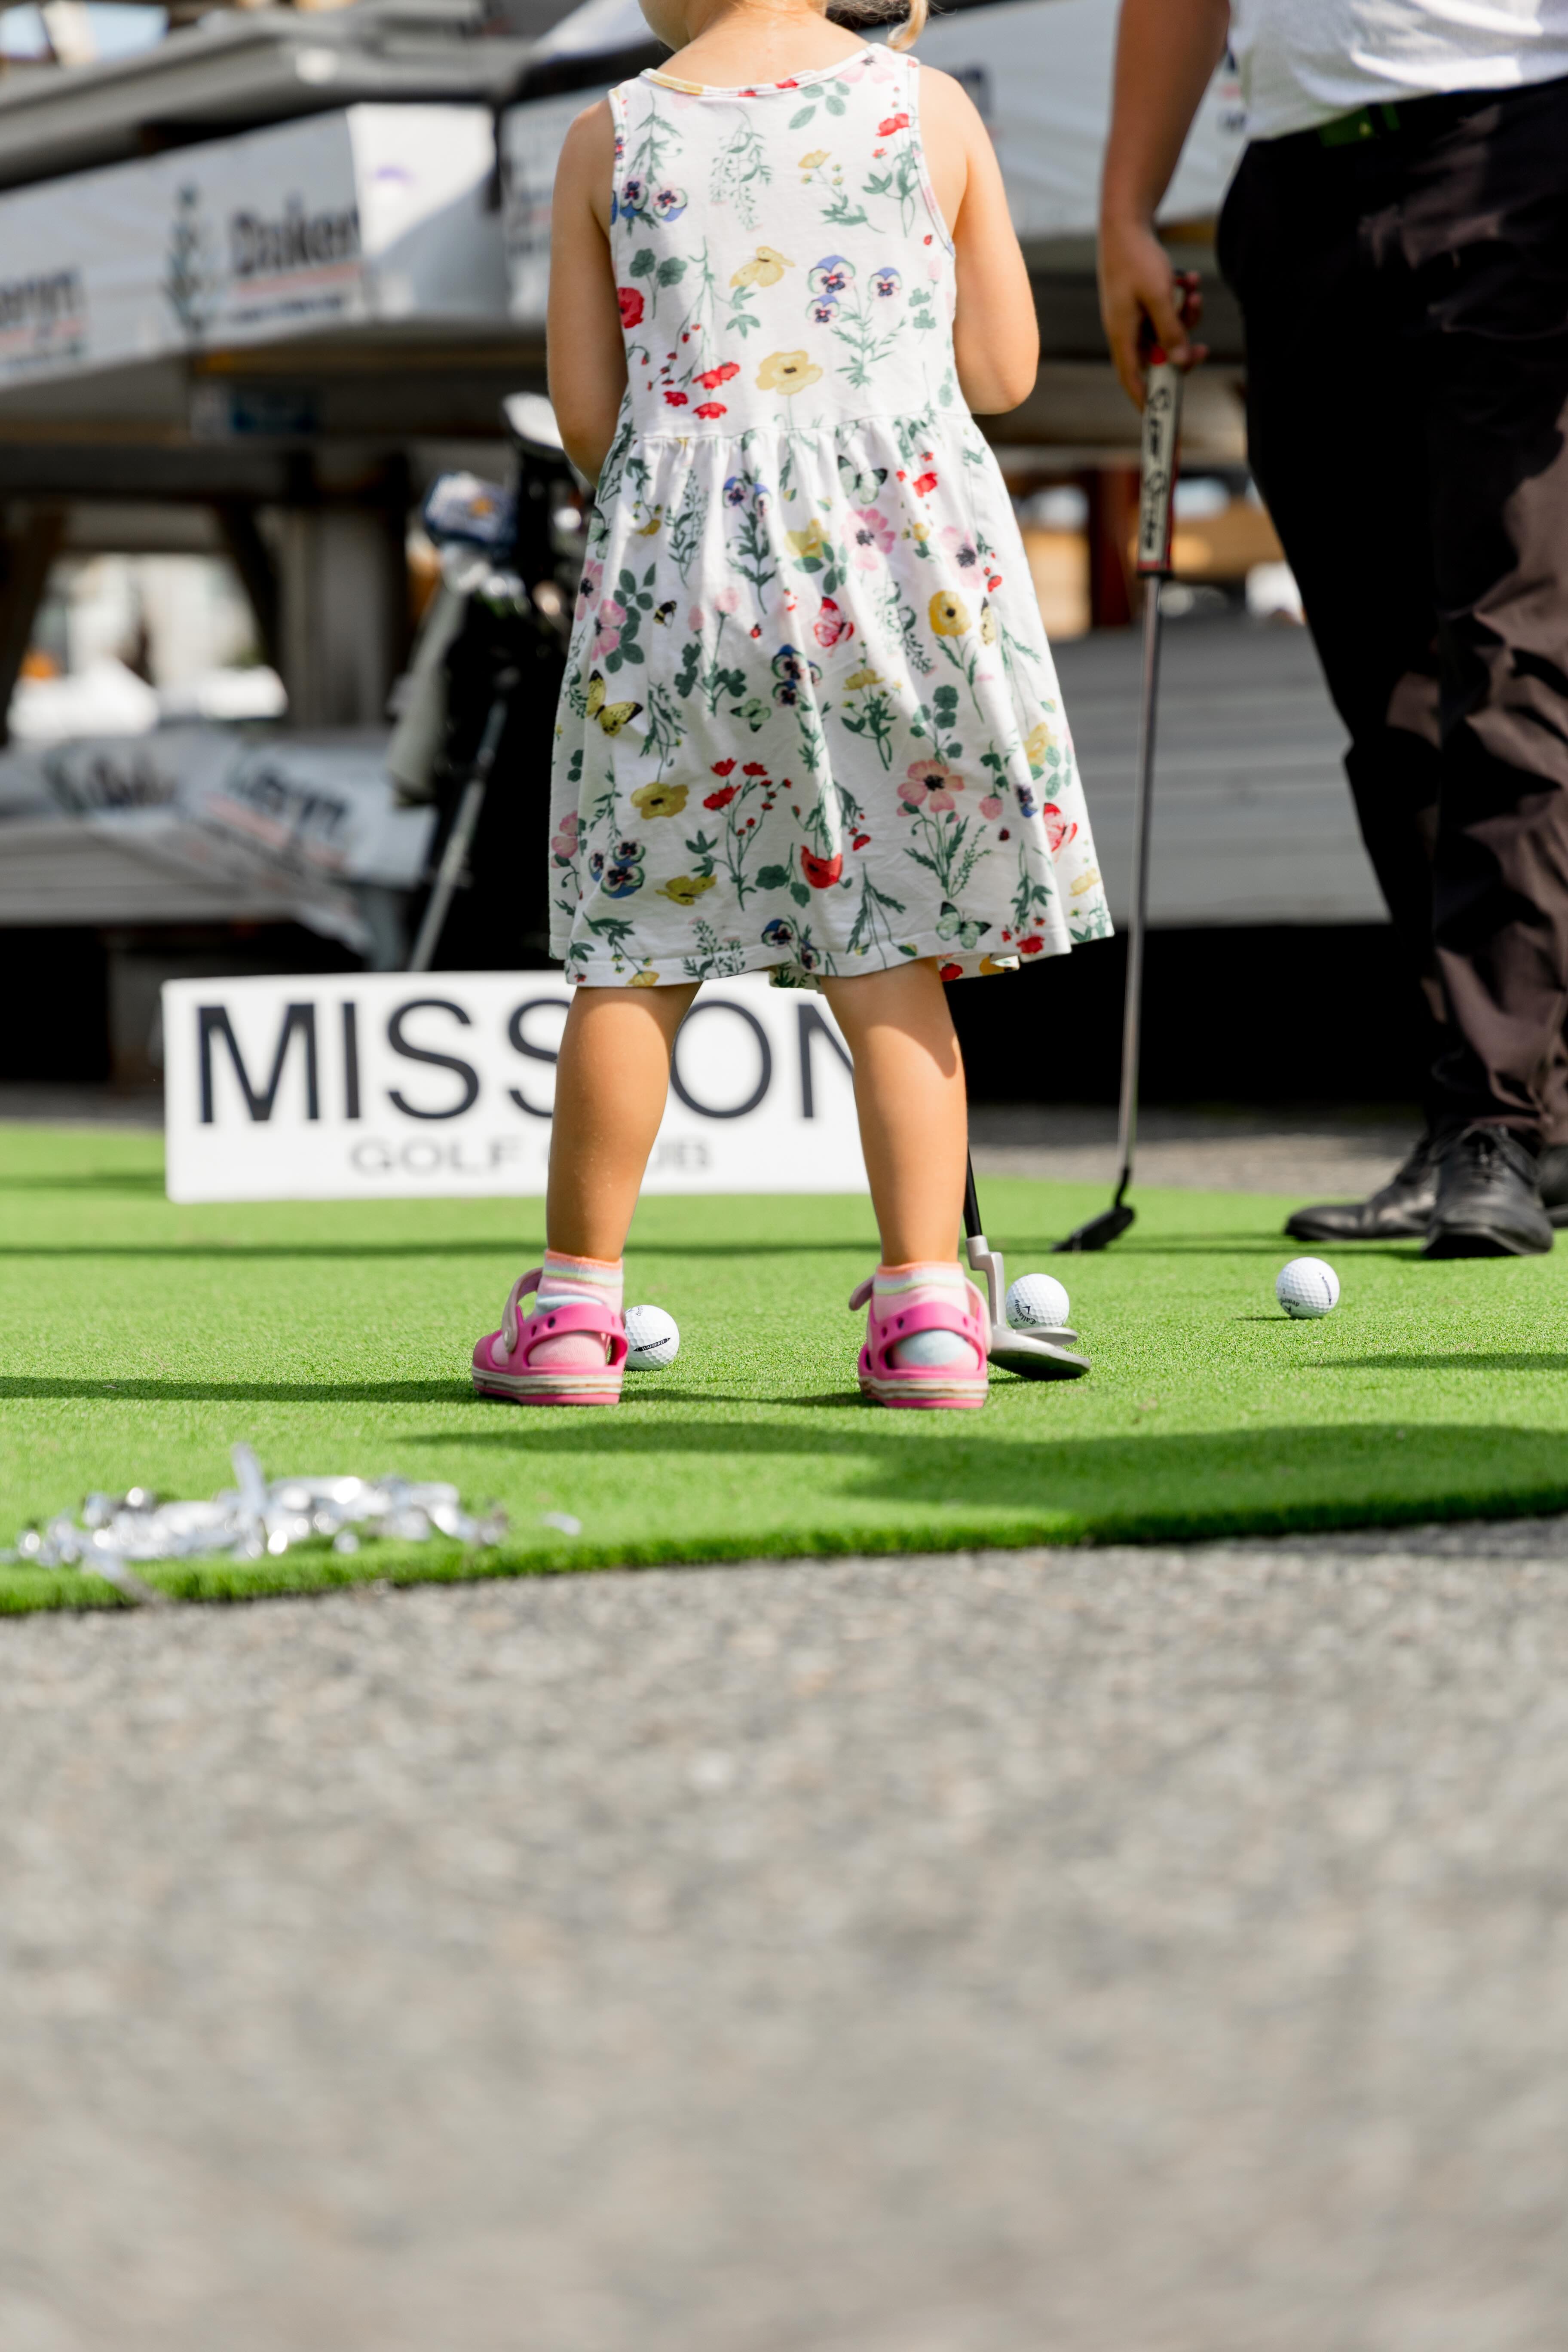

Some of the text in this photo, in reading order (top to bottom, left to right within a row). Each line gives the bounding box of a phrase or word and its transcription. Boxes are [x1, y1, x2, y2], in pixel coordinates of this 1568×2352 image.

[198, 998, 854, 1124] MISSON
[350, 1135, 526, 1179] GOLF
[1015, 1299, 1036, 1325] Callaway
[641, 1340, 665, 1351] WARBIRD
